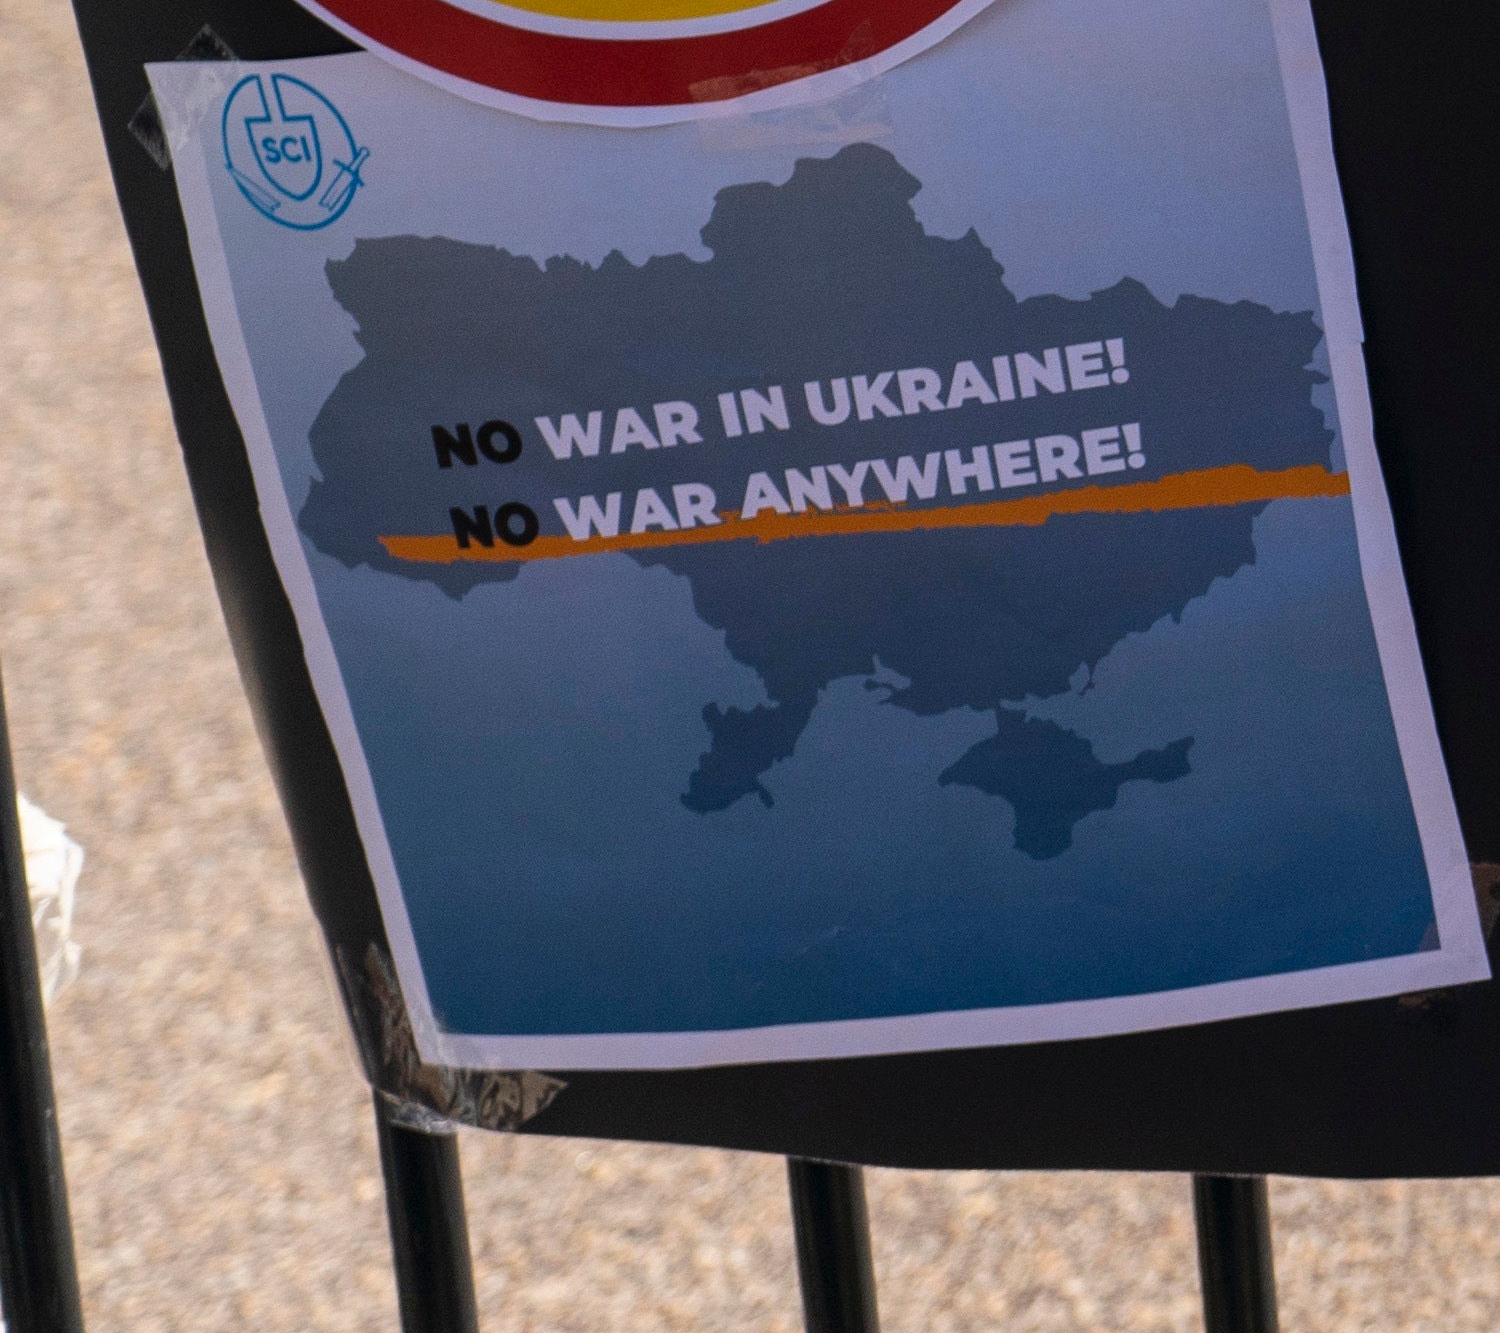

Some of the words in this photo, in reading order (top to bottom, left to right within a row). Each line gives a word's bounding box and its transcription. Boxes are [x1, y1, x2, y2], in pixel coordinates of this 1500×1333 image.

[262, 136, 311, 164] SCI
[431, 419, 523, 469] NO
[534, 400, 703, 460] WAR
[717, 385, 791, 438] IN
[804, 337, 1130, 427] UKRAINE!
[450, 501, 540, 549] NO
[552, 482, 721, 541] WAR
[740, 422, 1146, 521] ANYWHERE!
